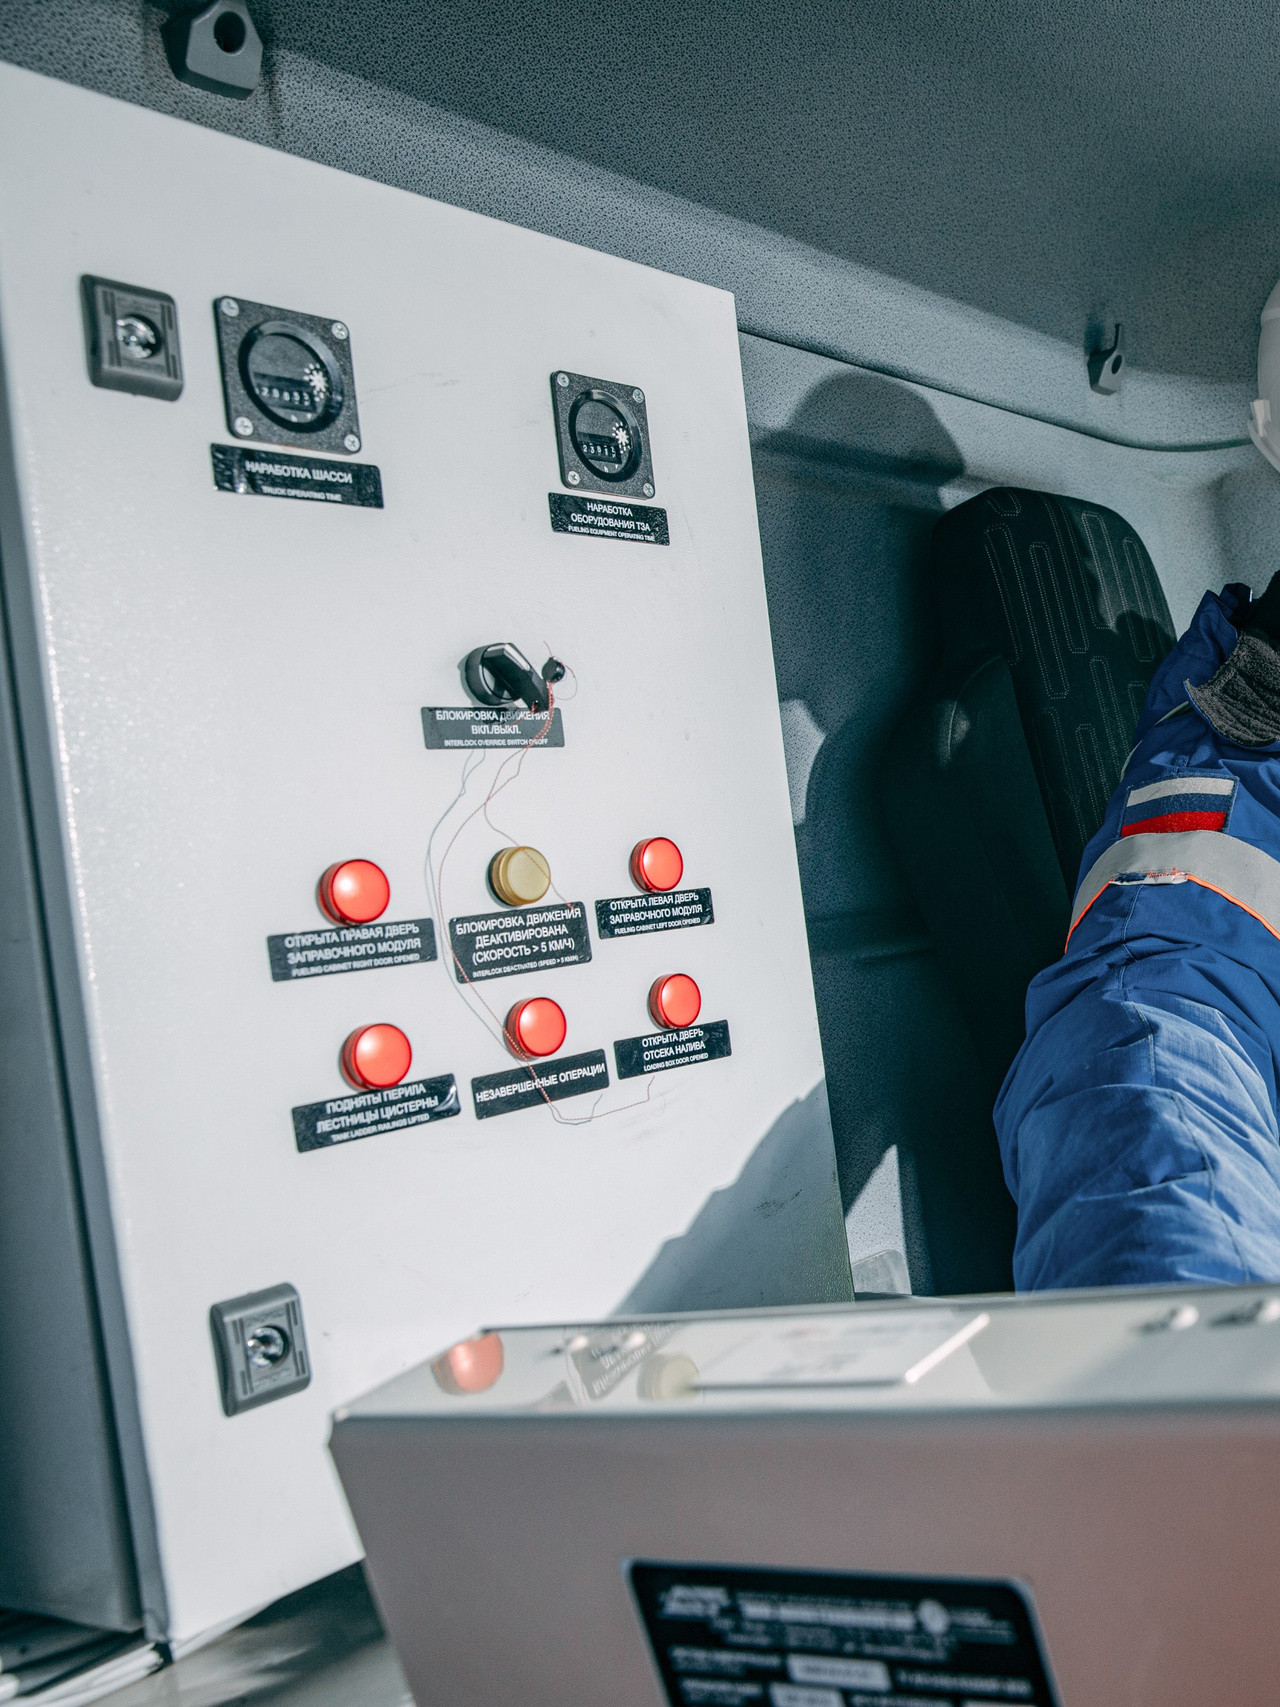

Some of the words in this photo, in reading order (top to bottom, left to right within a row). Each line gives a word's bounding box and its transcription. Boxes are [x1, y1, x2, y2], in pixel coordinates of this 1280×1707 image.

[245, 461, 311, 479] НАРАБОТКА
[312, 469, 352, 484] ШАССИ
[587, 502, 633, 517] НАРАБОТКА
[570, 513, 635, 529] ОБОРУДОВАНИЯ
[636, 521, 651, 531] ТЗА
[568, 525, 590, 534] FUELING
[589, 527, 617, 537] EQUIPMENT
[617, 530, 645, 540] OPERATING
[435, 710, 499, 721] БЛОКИРОВКА
[500, 710, 550, 722] ДВИЖЕНИЯ
[444, 739, 478, 747] INTERLOCK
[477, 739, 507, 747] OVERRIDE
[609, 898, 648, 911] ОТКРЫТА
[648, 895, 674, 907] ЛЕВАЯ
[674, 892, 699, 904] ДВЕРЬ
[456, 915, 525, 935] БЛОКИРОВКА
[526, 908, 581, 927] ДВИЖЕНИЯ
[609, 908, 671, 925] ЗАПРАВОЧНОГО
[671, 904, 703, 917] МОДУЛЯ
[284, 932, 339, 949] ОТКРЫТА
[340, 926, 384, 942] ПРАВАЯ
[384, 923, 420, 939] ДВЕРЬ
[614, 926, 635, 935] FUELING
[635, 923, 656, 932] CABINET
[656, 921, 668, 929] LEFT
[667, 920, 682, 928] DOOR
[682, 917, 701, 926] OPENED
[475, 924, 568, 949] ДЕАКТИВИРОВАНА
[287, 943, 377, 965] ЗАПРАВОЧНОГО
[378, 938, 422, 953] МОДУЛЯ
[472, 944, 531, 966] (СКОРОСТЬ
[541, 942, 547, 953] 5
[548, 938, 575, 952] КМ/Ч)
[292, 964, 322, 977] FUELING
[323, 961, 351, 974] CABINET
[352, 958, 373, 969] RIGHT
[373, 956, 393, 967] DOOR
[394, 953, 420, 964] OPENED
[472, 967, 503, 978] INTERLOCK
[503, 961, 537, 974] DEACTIVATED
[641, 1033, 678, 1047] ОТКРЫТА
[679, 1027, 704, 1042] ДВЕРЬ
[643, 1047, 674, 1060] ОТСЕКА
[675, 1040, 706, 1054] НАЛИВА
[643, 1061, 665, 1071] LOADING
[665, 1060, 675, 1068] BOX
[675, 1057, 690, 1065] DOOR
[689, 1053, 709, 1062] OPENED
[475, 1074, 559, 1102] НЕЗАВЕРШЕННЫЕ
[558, 1062, 606, 1083] ОПЕРАЦИИ
[326, 1092, 382, 1114] ПОДНЯТЫ
[383, 1083, 426, 1101] ПЕРИЛА
[316, 1109, 379, 1134] ЛЕСТНИЦЫ
[380, 1095, 439, 1119] ЦИСТЕРНЫ
[408, 1113, 430, 1126] LIFTED
